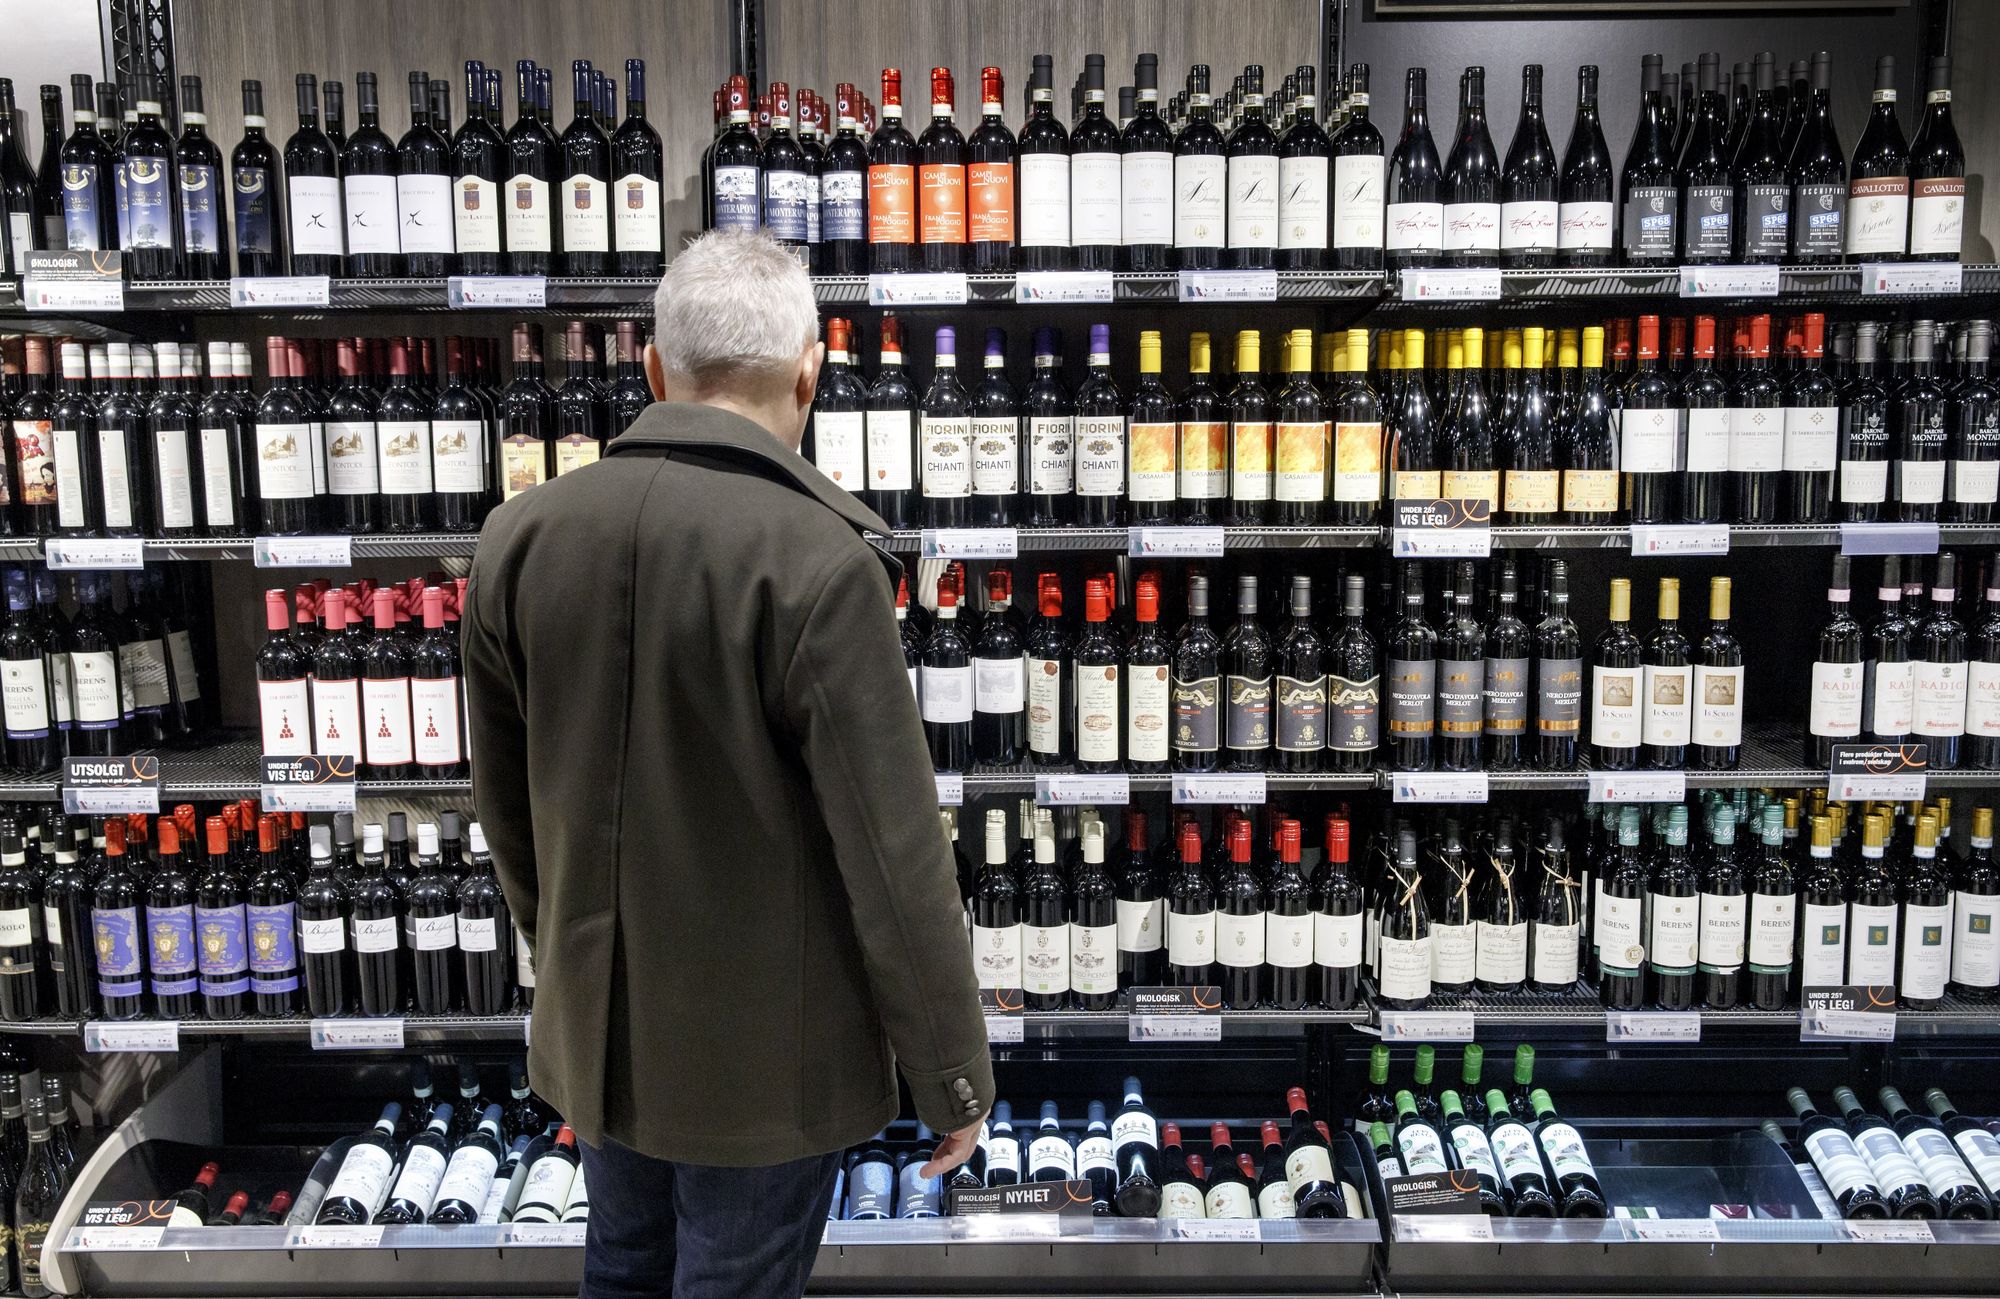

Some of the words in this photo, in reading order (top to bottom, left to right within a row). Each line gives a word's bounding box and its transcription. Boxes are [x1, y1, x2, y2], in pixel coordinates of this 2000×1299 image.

[884, 178, 909, 186] NUOVI
[937, 178, 961, 186] NUOVI
[984, 176, 1008, 184] NUOVI
[1754, 187, 1790, 196] OCCHIPIN
[1852, 184, 1904, 194] CAVALLOTTO
[1923, 185, 1965, 194] CAVALLOTT
[1643, 216, 1669, 228] SP68
[1703, 215, 1729, 227] SP68
[1764, 214, 1788, 226] SP68
[1811, 213, 1838, 226] SP68
[31, 258, 78, 268] ØKOLOGISK
[926, 425, 967, 435] FIORINI
[973, 424, 1014, 434] FIORINI
[1080, 423, 1121, 433] FIORINI
[1850, 433, 1889, 441] MONTALTO
[1966, 433, 2000, 441] MONTALT
[928, 462, 964, 471] CHIANTI
[976, 460, 1011, 470] CHIANTI
[1082, 460, 1119, 470] CHIANTI
[1423, 506, 1436, 514] 25?
[1400, 514, 1418, 525] VIS
[1421, 514, 1448, 525] LEG!
[1822, 681, 1861, 690] RADIC
[1500, 691, 1524, 699] D'AVOLA
[1446, 699, 1471, 707] MERLOT
[1491, 697, 1517, 705] MERLOT
[71, 764, 125, 776] UTSOLGT
[267, 770, 286, 781] VIS
[289, 770, 314, 781] LEG!
[1602, 918, 1630, 930] BERENS
[1661, 920, 1693, 929] BERENS
[1708, 919, 1740, 928] BERENS
[1761, 919, 1792, 927] BERENS
[1136, 994, 1180, 1002] ØKOLOGISK
[1808, 1000, 1827, 1010] VIS
[1829, 1000, 1854, 1010] LEG!
[1392, 1181, 1438, 1193] ØKOLOGISK
[1005, 1189, 1050, 1204] NYHET
[85, 1213, 103, 1224] VIS
[105, 1213, 133, 1224] LEG!
